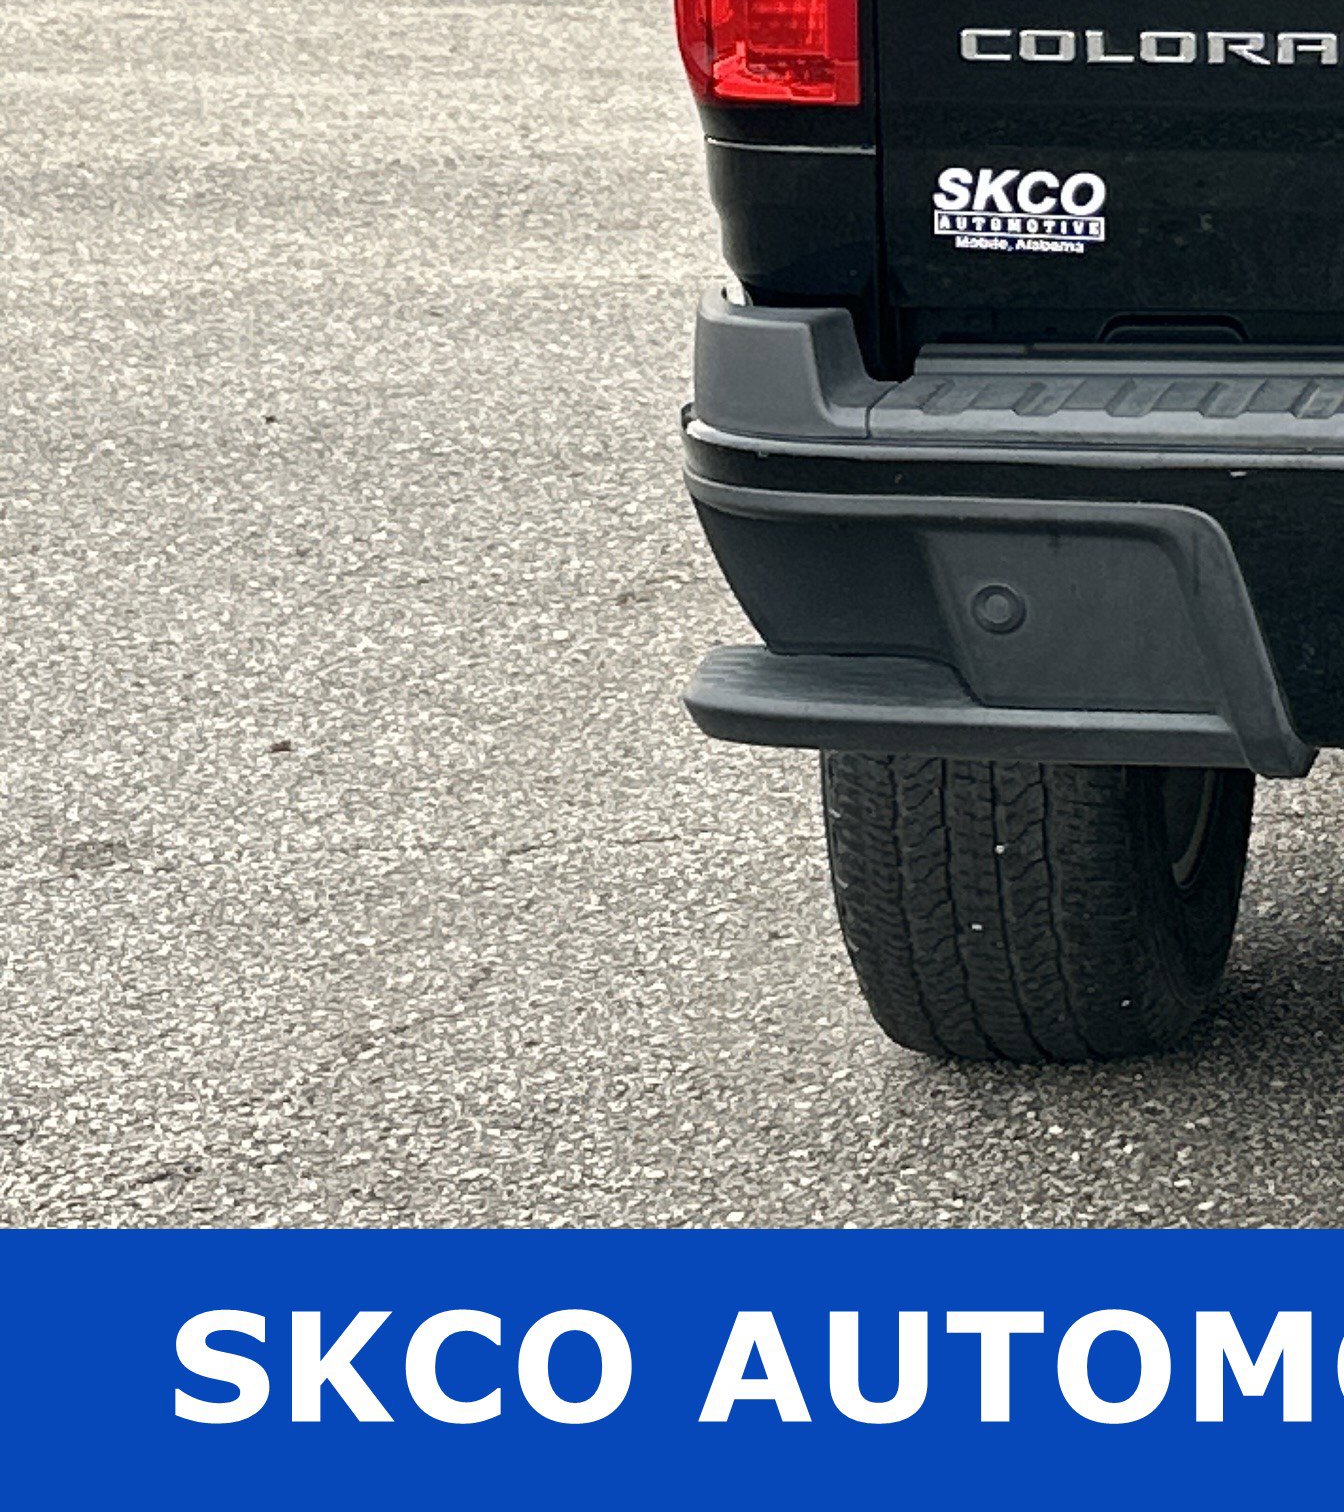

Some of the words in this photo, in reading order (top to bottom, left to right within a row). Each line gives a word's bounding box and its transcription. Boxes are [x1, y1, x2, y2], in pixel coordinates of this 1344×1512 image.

[933, 167, 1106, 216] SKCO
[939, 215, 1100, 236] AUTOMOTIVE
[1015, 240, 1084, 254] Alabama
